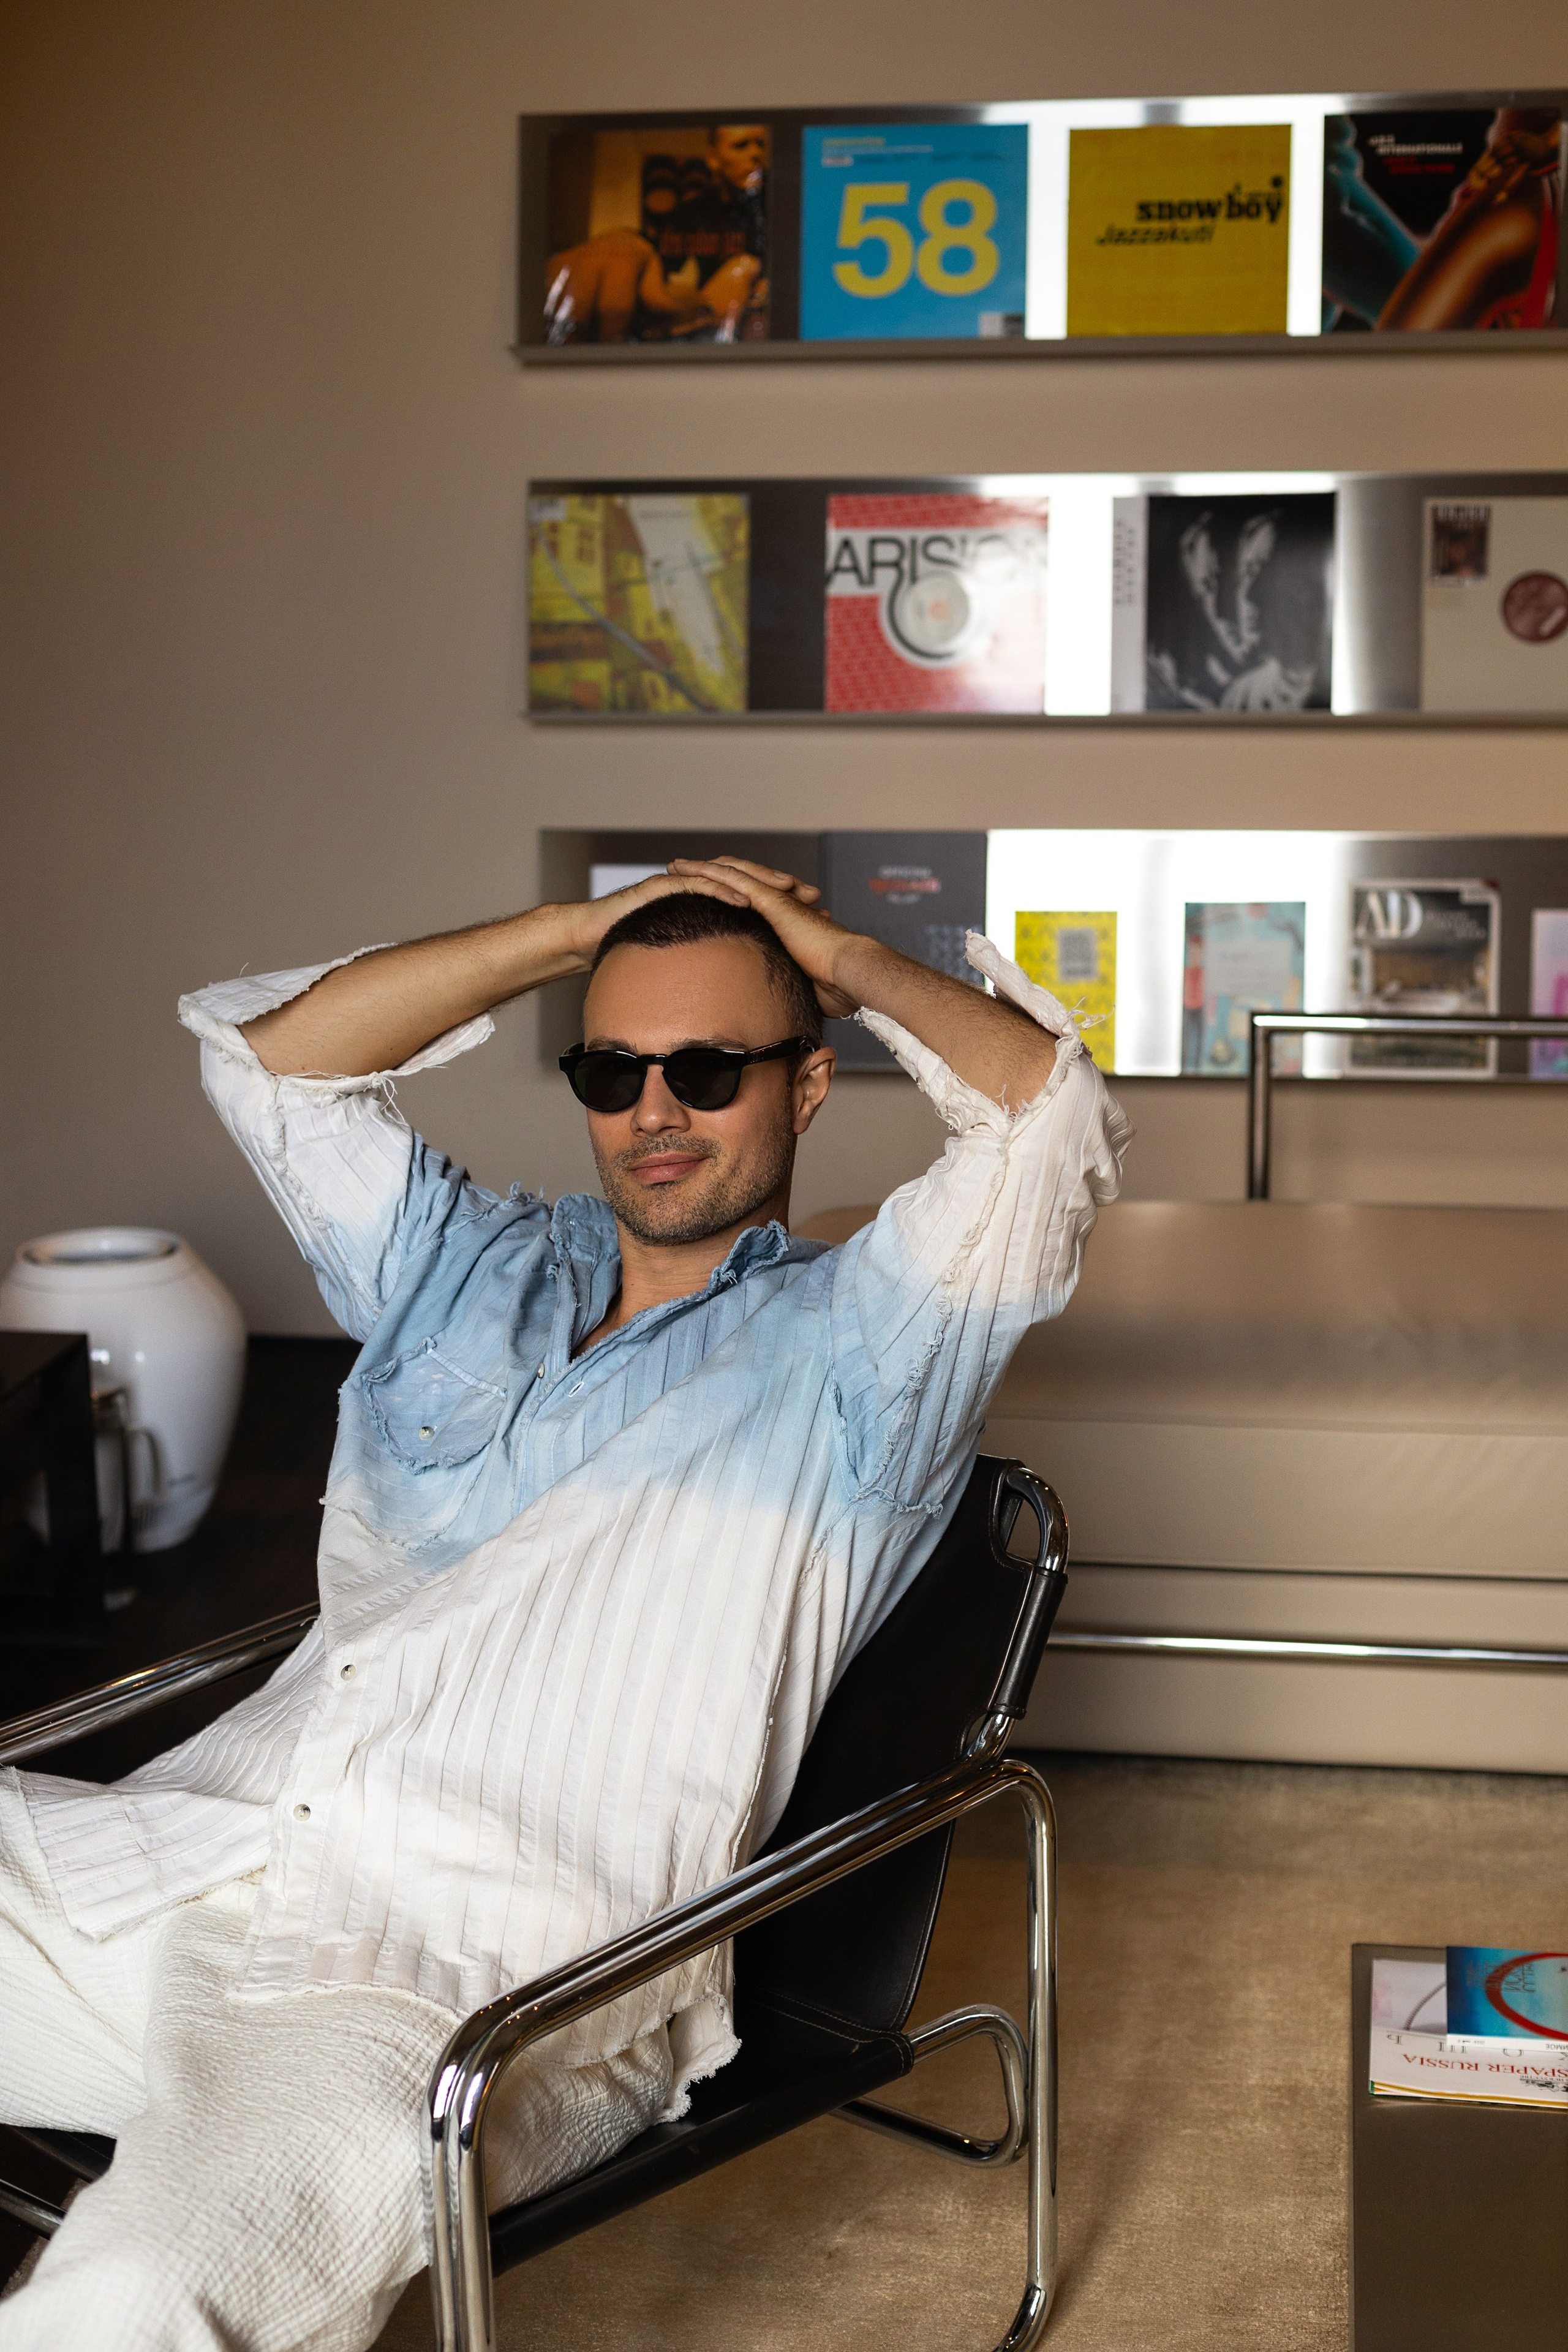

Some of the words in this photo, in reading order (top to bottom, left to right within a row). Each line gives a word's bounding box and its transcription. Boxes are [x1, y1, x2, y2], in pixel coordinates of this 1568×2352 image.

[834, 178, 1000, 298] 58
[1354, 891, 1424, 939] AD
[1402, 2053, 1479, 2071] RUSSIA
